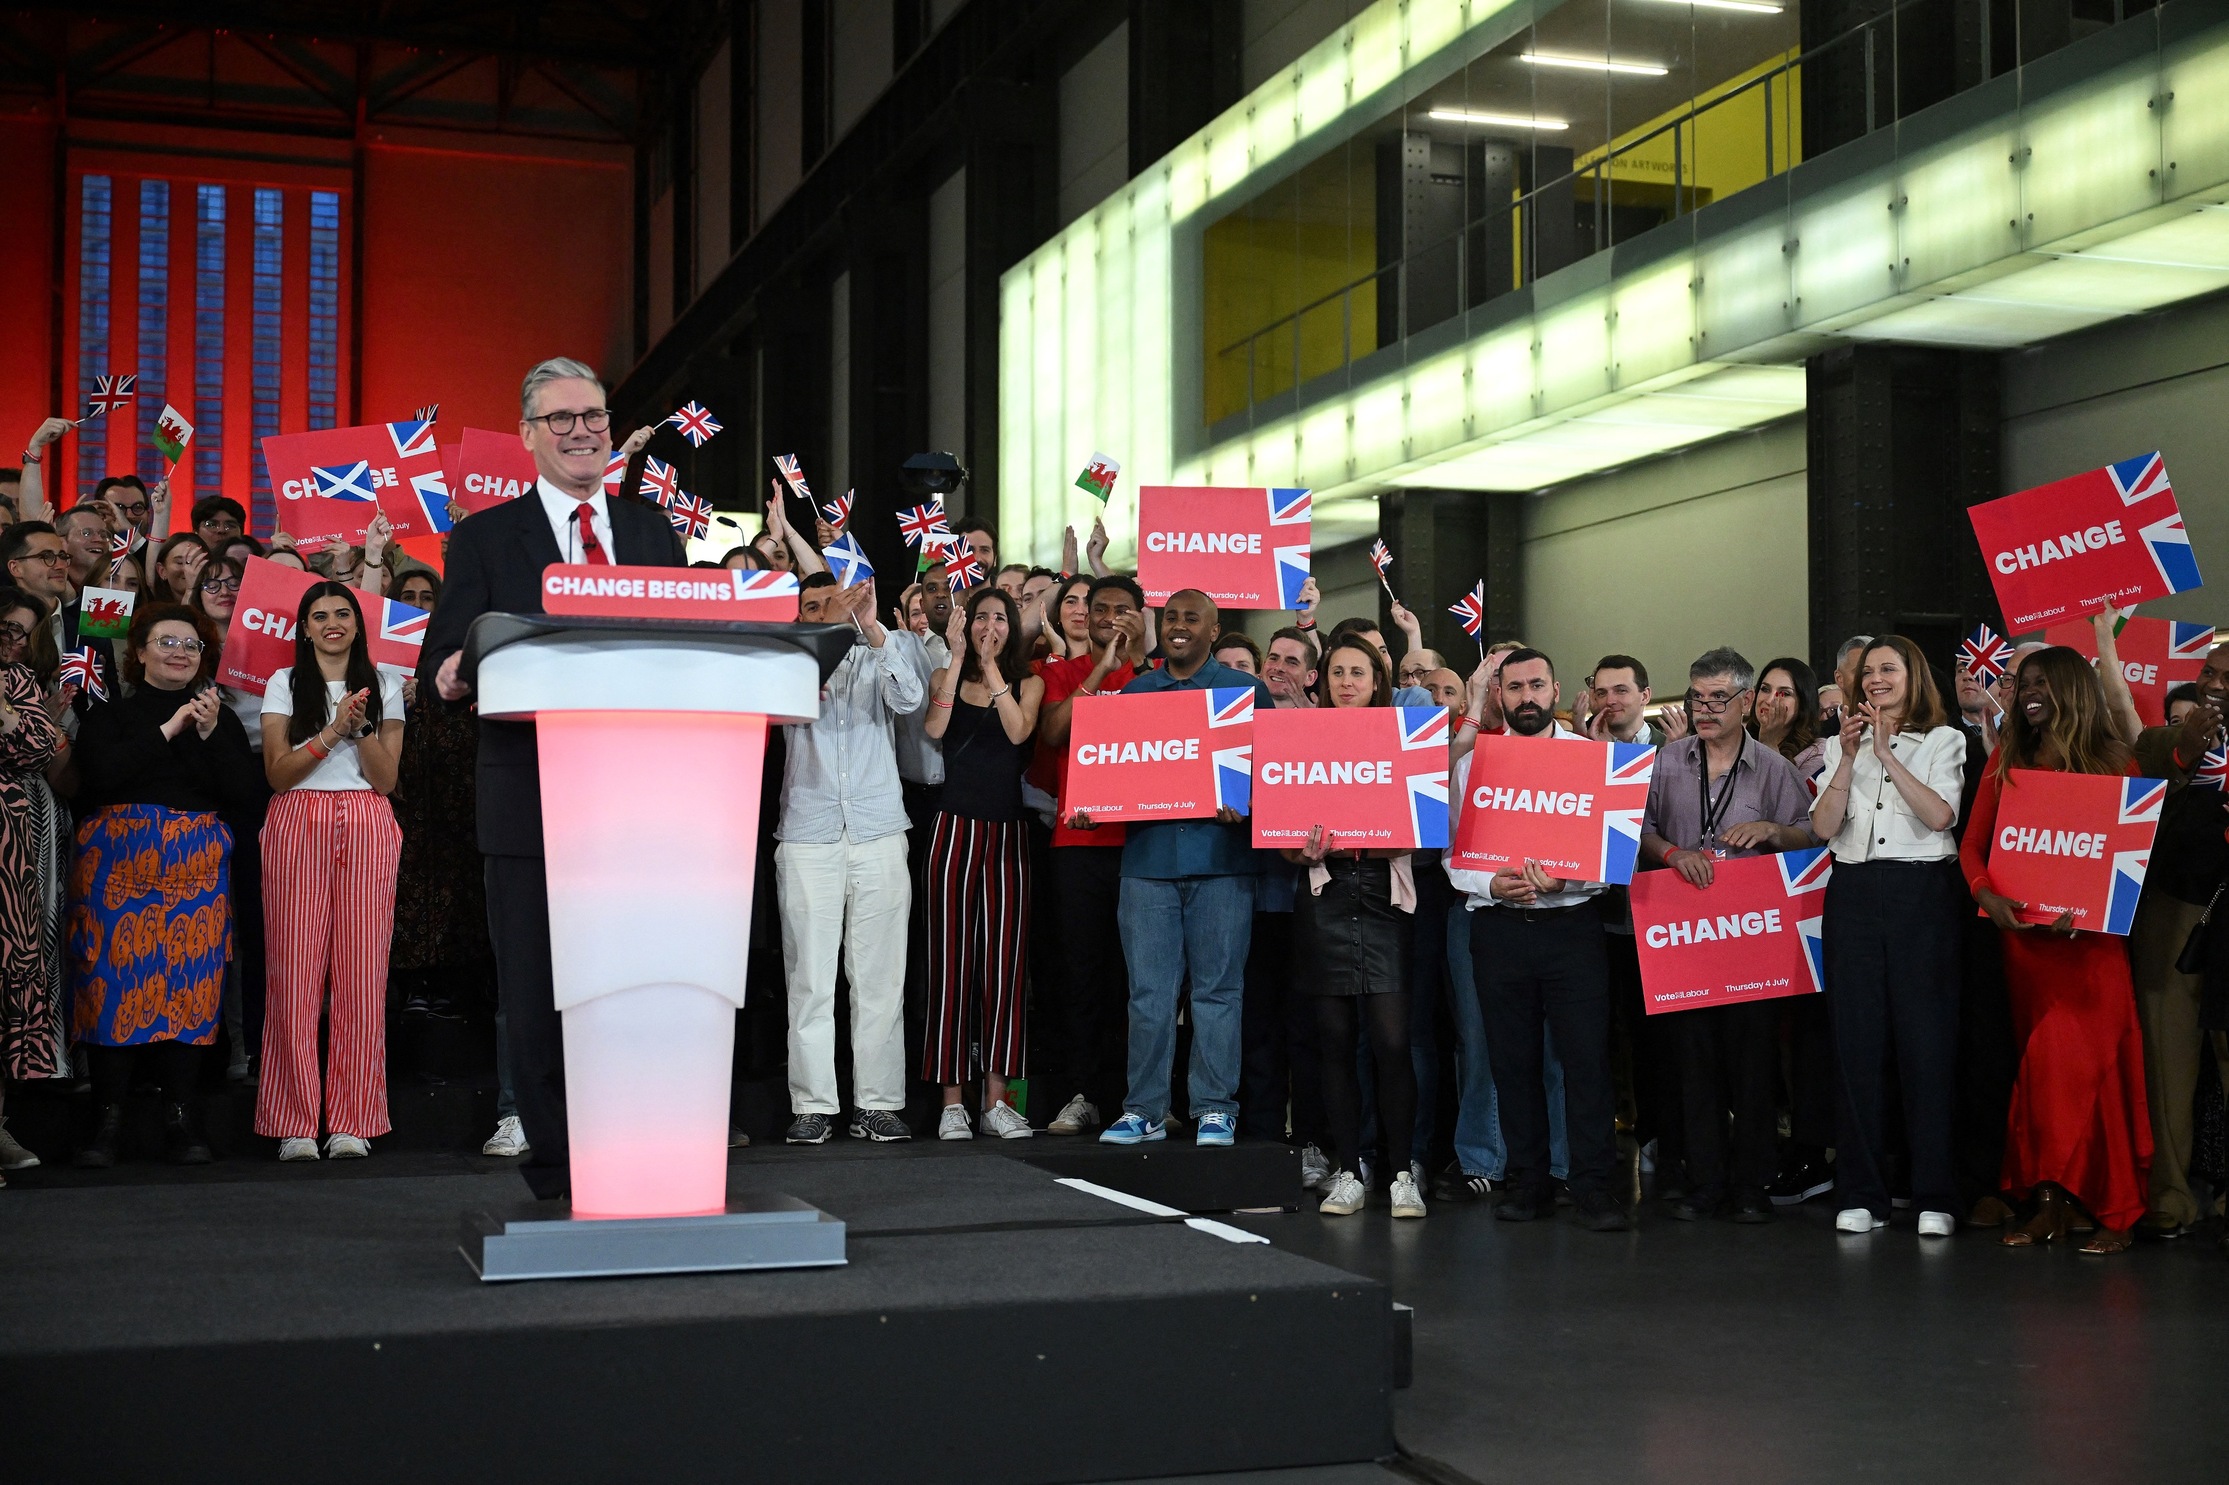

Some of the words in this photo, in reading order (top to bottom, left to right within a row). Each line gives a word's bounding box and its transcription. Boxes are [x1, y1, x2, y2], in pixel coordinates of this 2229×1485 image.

[1631, 160, 1688, 173] ARTWORS
[282, 467, 399, 500] CHGE
[465, 473, 532, 499] CHA
[396, 522, 410, 530] July
[1146, 531, 1262, 554] CHANGE
[1995, 520, 2126, 575] CHANGE
[546, 576, 645, 598] CHANGE
[648, 580, 732, 601] BEGINS
[2125, 585, 2142, 595] July
[1245, 592, 1260, 601] July
[2013, 615, 2034, 624] Vote
[2038, 605, 2066, 618] Labour
[228, 667, 248, 680] Vote
[1077, 738, 1200, 765] CHANGE
[1261, 761, 1392, 785] CHANGE
[1073, 805, 1092, 813] Vote
[1098, 804, 1124, 812] Labour
[1137, 802, 1172, 811] Thursday
[1179, 801, 1196, 810] July
[1472, 786, 1594, 817] CHANGE
[1261, 829, 1281, 837] Vote
[1287, 829, 1310, 837] Labou
[1368, 829, 1374, 837] 4
[1375, 829, 1392, 839] July
[2000, 826, 2107, 859] CHANGE
[1461, 850, 1480, 860] Vote
[1485, 853, 1510, 862] Labour
[1564, 860, 1580, 870] July
[2073, 907, 2088, 918] July
[1645, 908, 1782, 949] CHANGE
[1725, 981, 1764, 992] Thursday
[1772, 978, 1789, 987] July
[1654, 993, 1676, 1002] Vote
[1681, 988, 1710, 998] Labour
